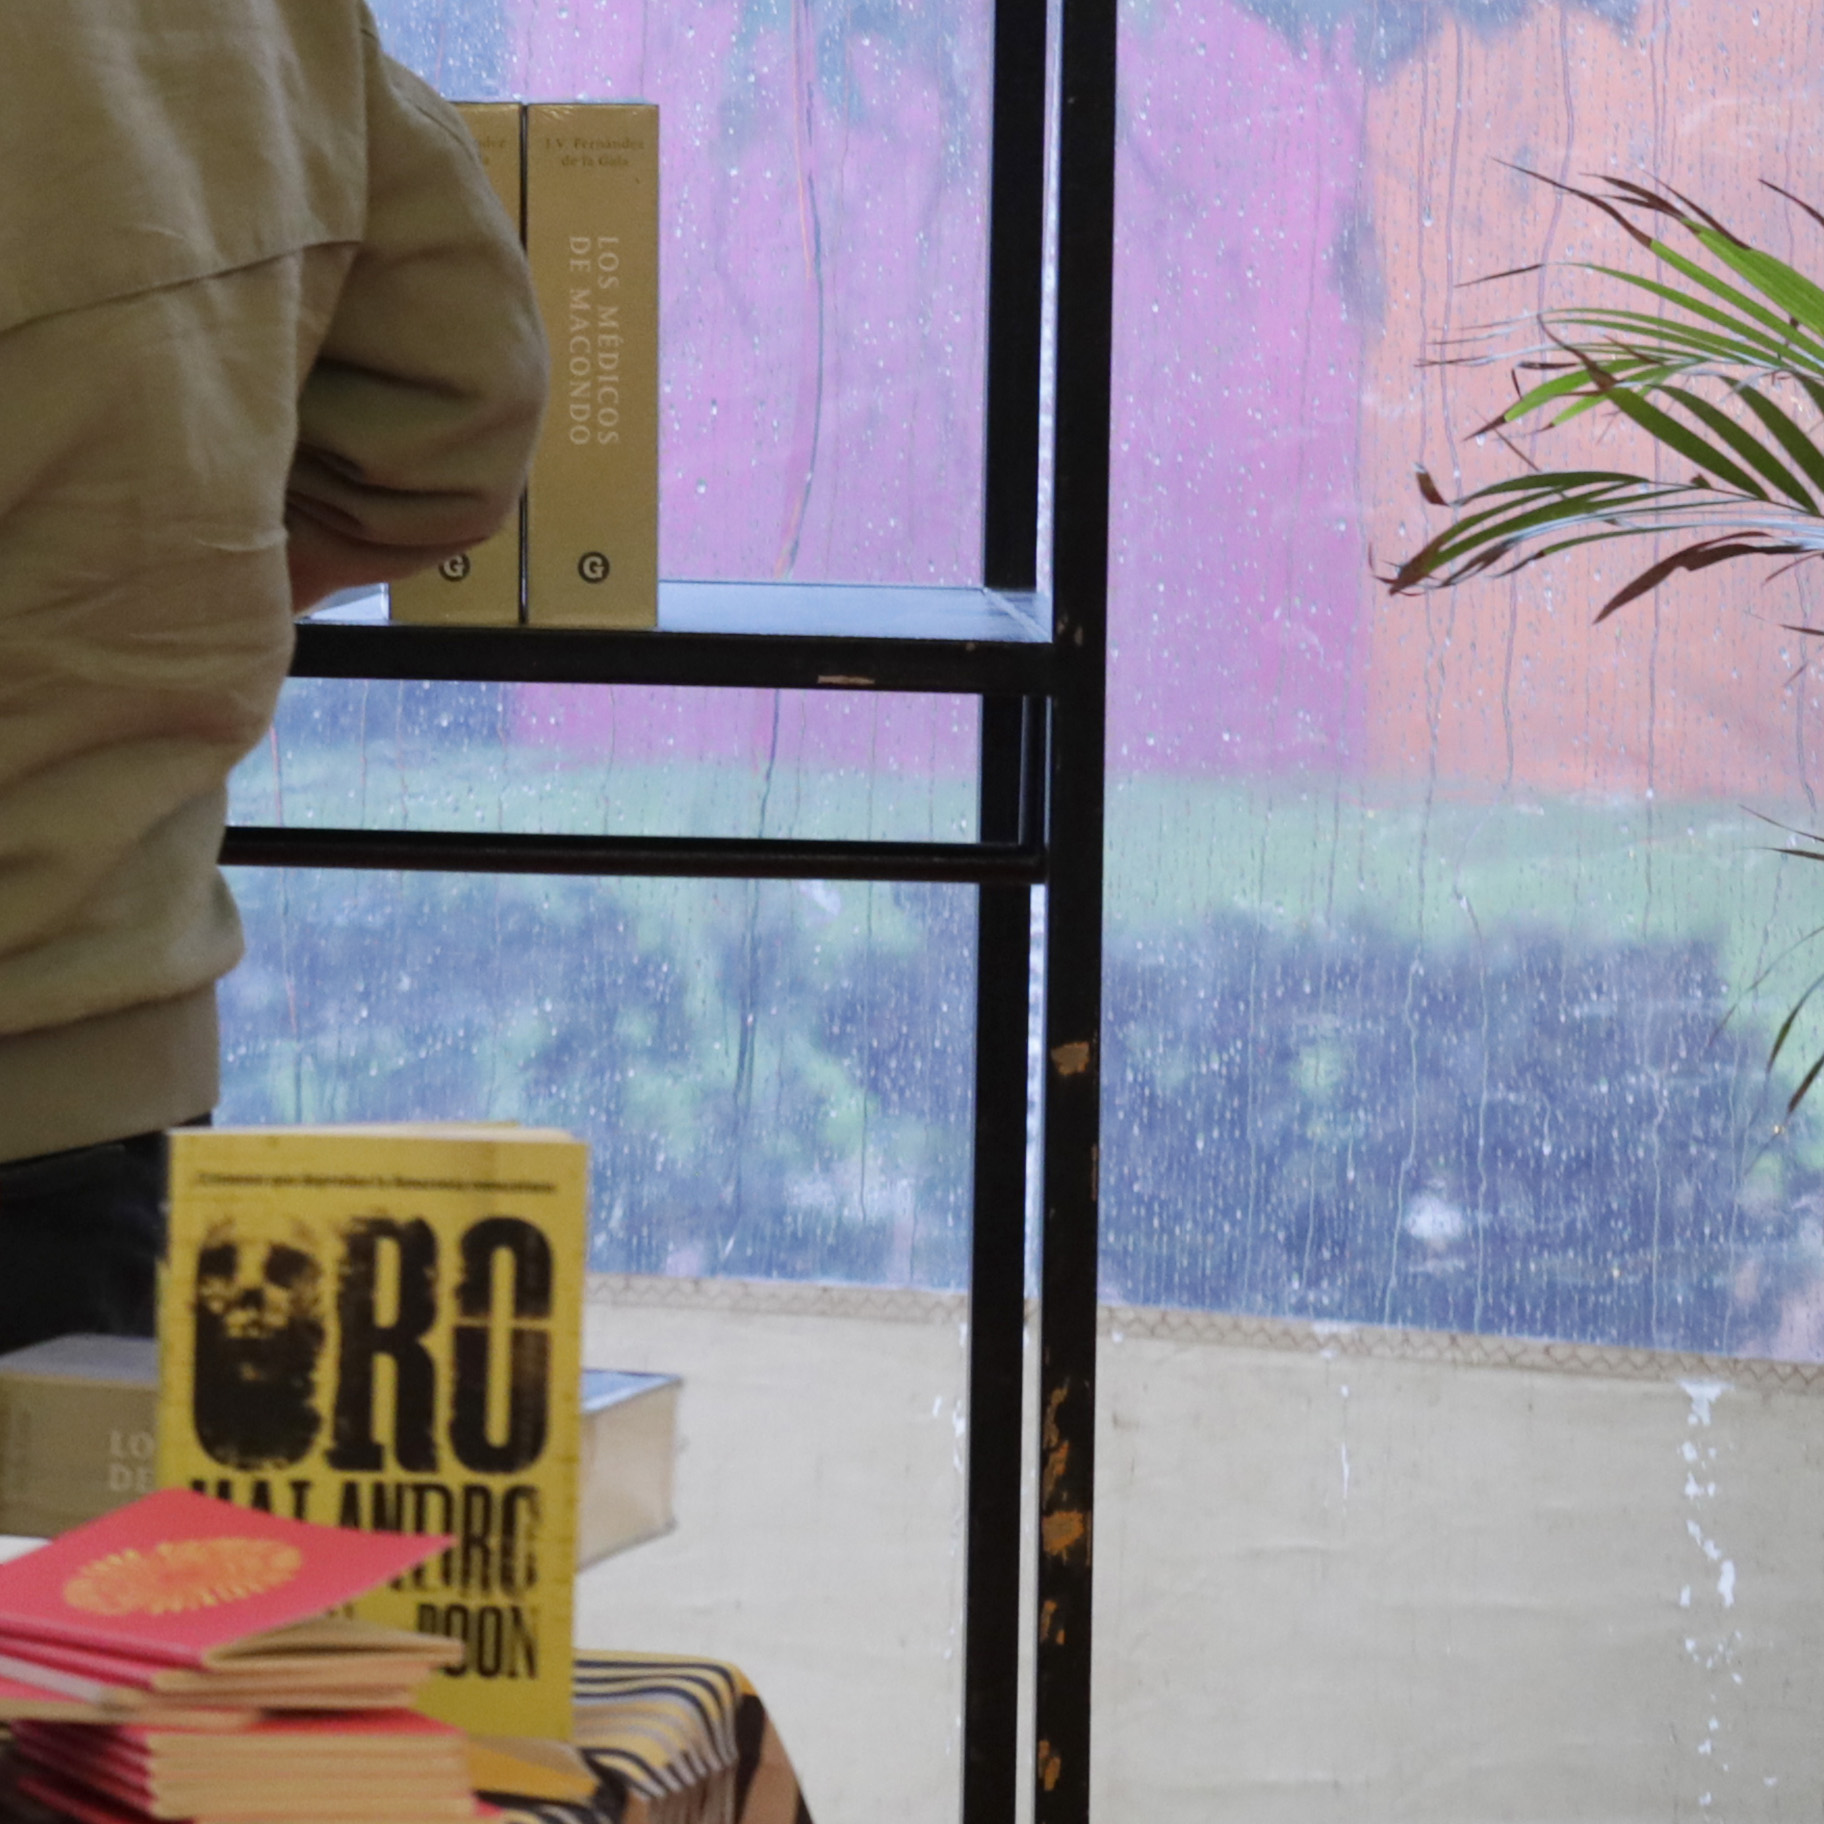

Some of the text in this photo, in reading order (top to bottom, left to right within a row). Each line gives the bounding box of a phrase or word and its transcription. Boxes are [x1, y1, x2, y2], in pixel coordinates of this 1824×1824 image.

[568, 236, 592, 446] DE MACONDO
[596, 236, 620, 447] LOS MÉDICOS
